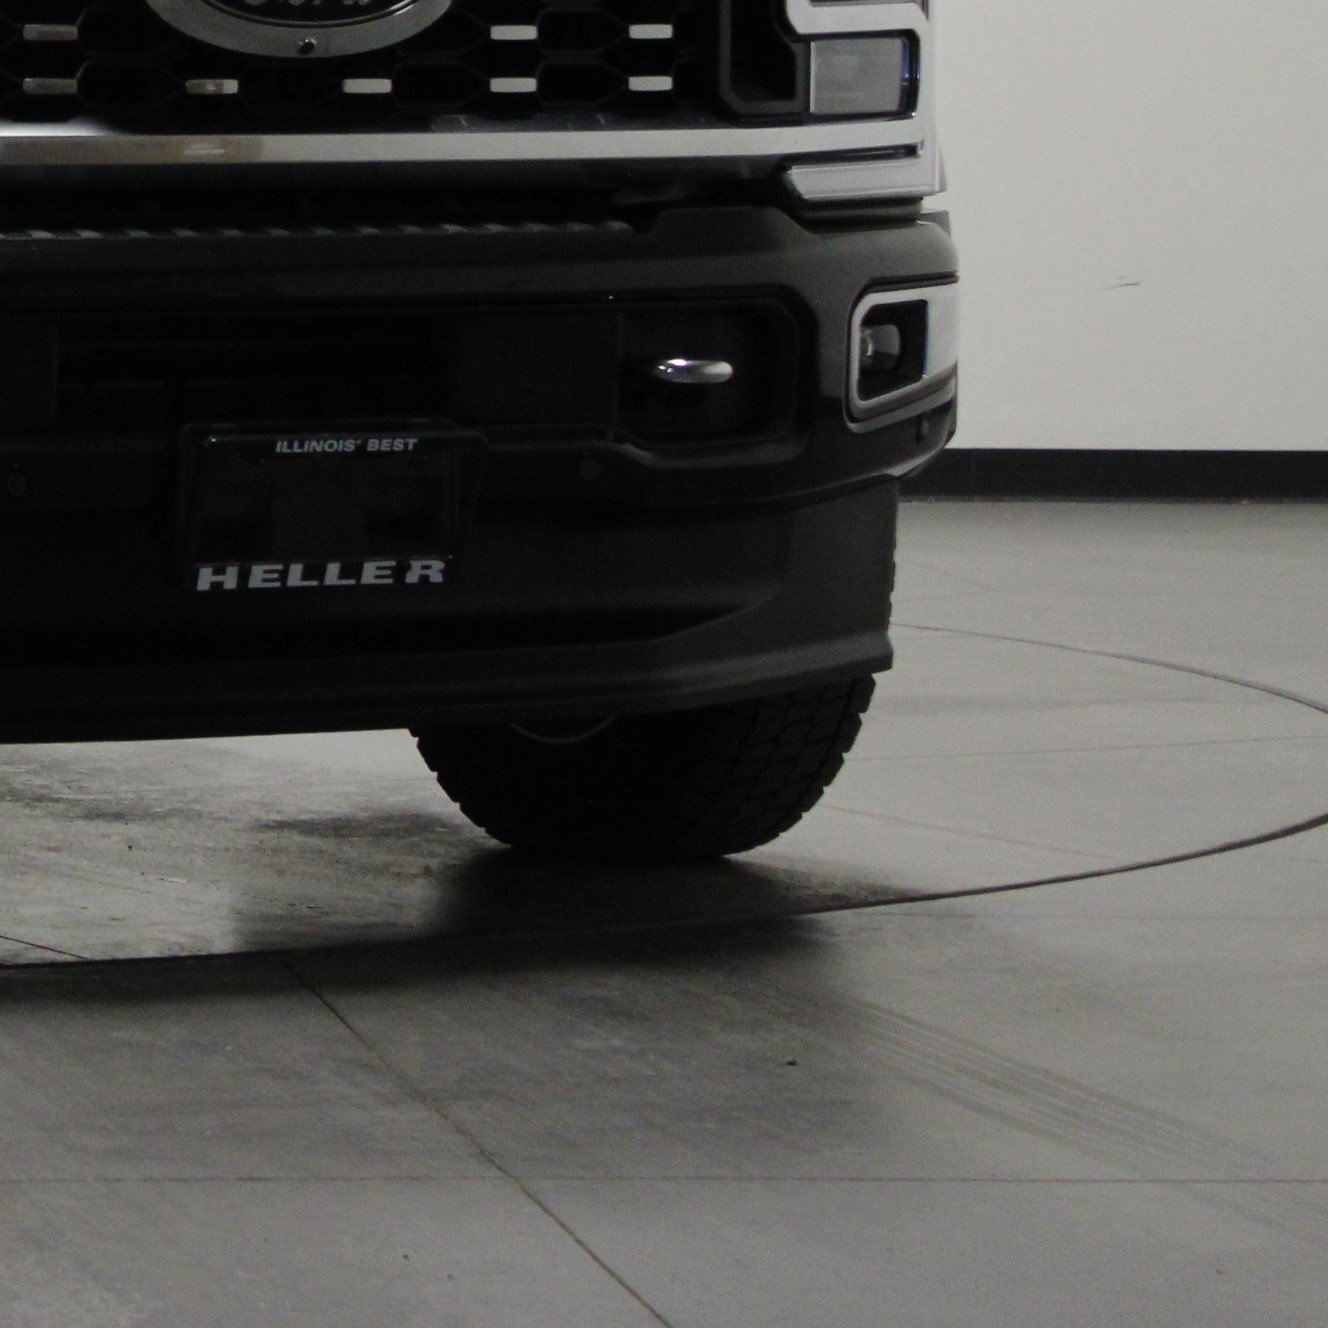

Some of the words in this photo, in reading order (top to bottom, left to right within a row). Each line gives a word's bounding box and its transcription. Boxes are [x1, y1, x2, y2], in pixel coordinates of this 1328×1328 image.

[275, 439, 363, 454] ILLINOIS'
[366, 438, 419, 453] BEST
[196, 559, 446, 592] HELLER
